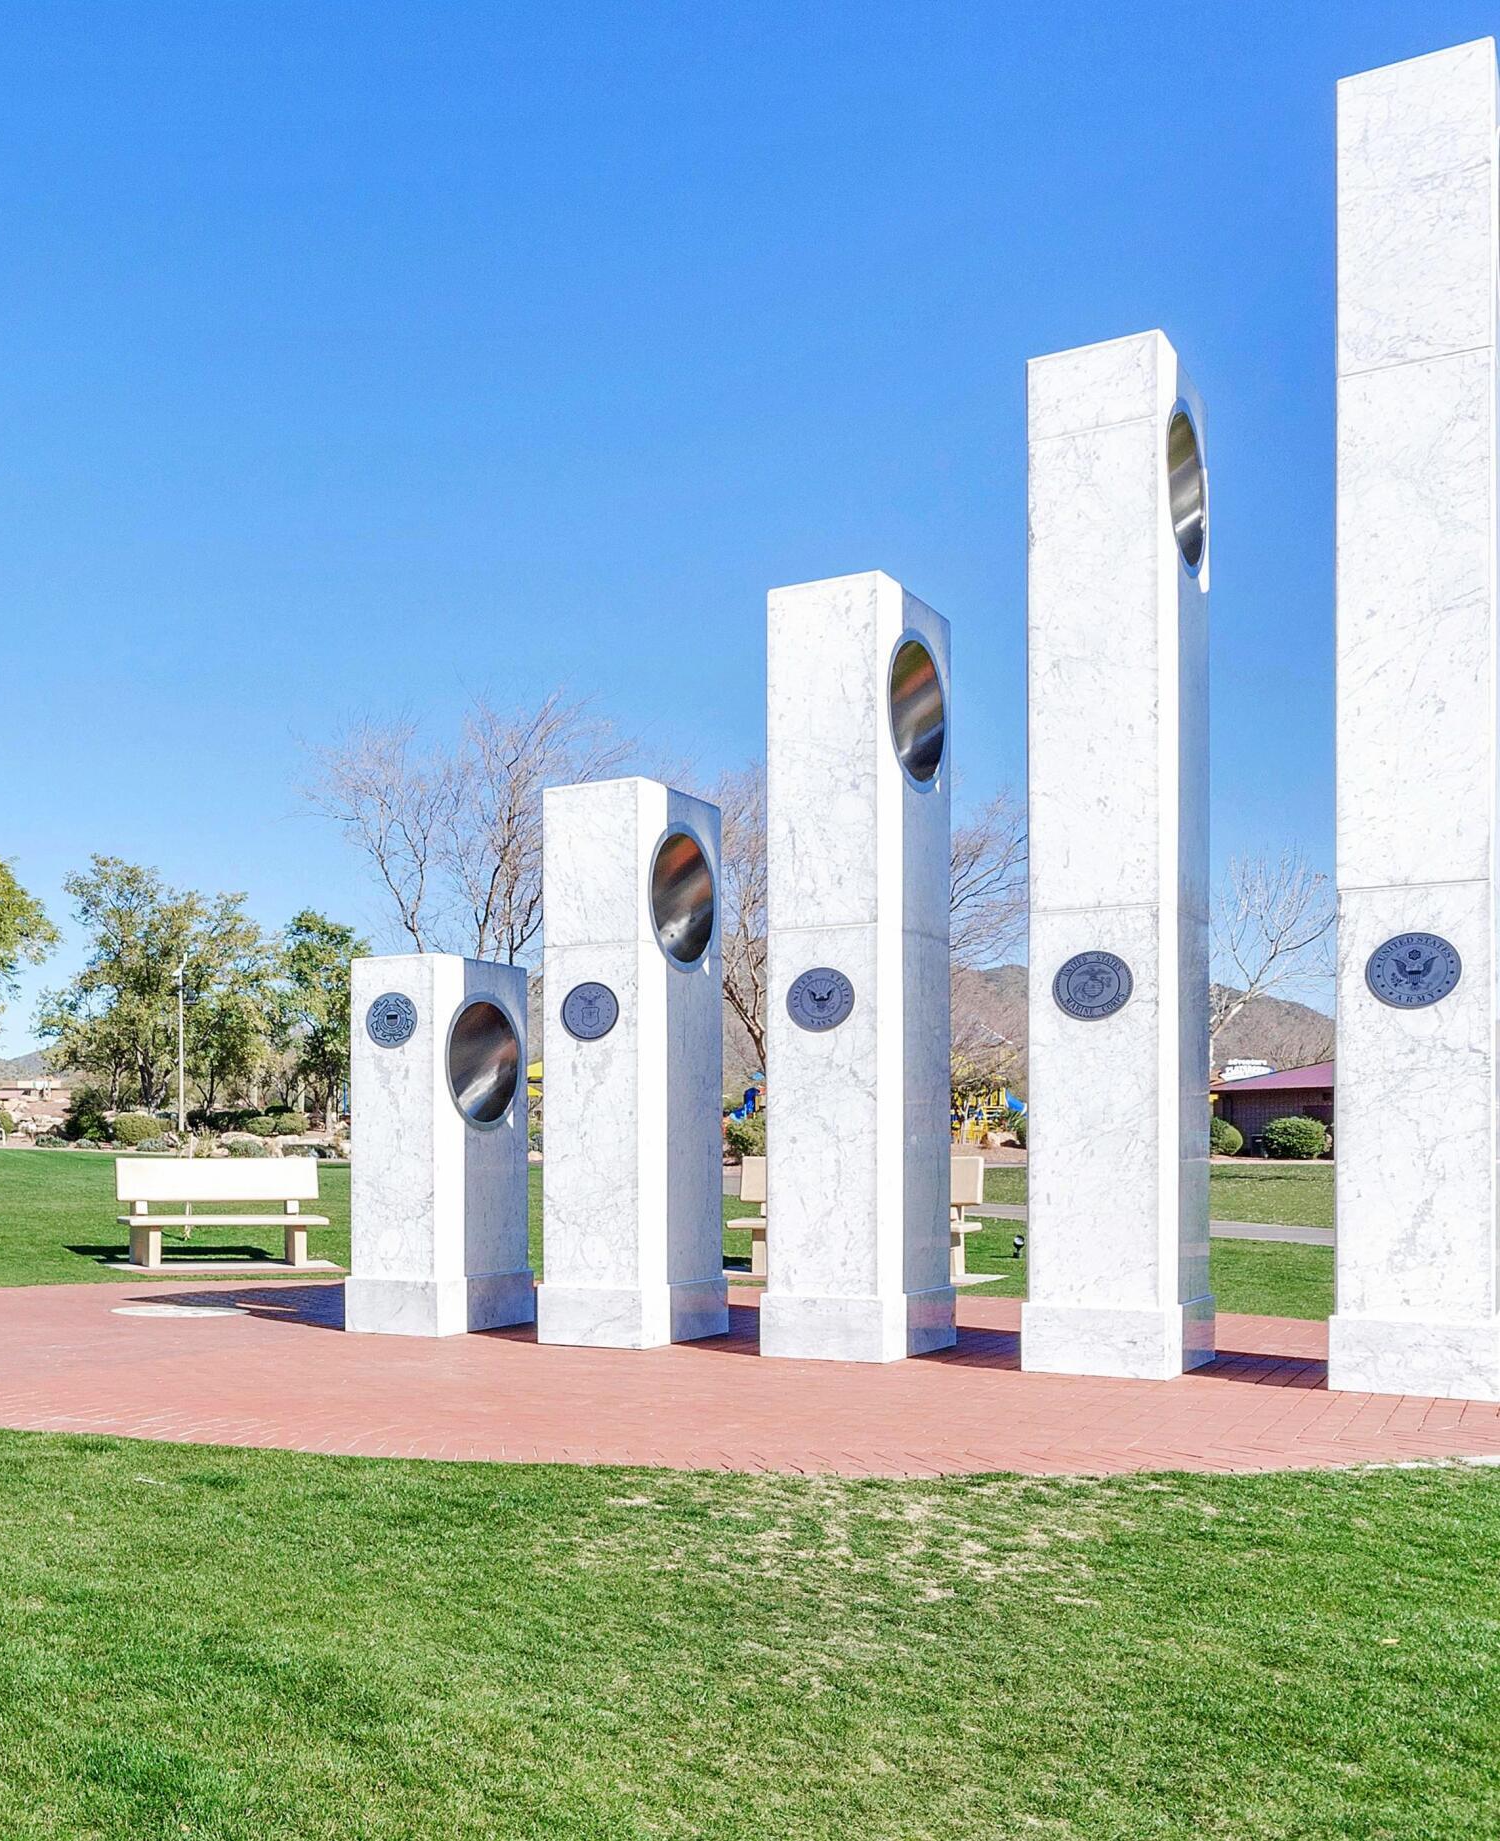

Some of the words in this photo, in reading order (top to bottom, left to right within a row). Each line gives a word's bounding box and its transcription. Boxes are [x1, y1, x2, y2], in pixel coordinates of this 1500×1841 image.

[1378, 936, 1414, 961] UNITED
[1417, 937, 1452, 959] STATES
[1060, 956, 1088, 977] UNITED
[1096, 954, 1123, 972] STATES
[793, 973, 813, 1008] UNITED
[1395, 991, 1435, 1003] ARMY
[1066, 997, 1093, 1015] MARINE
[1101, 992, 1125, 1013] CORPS
